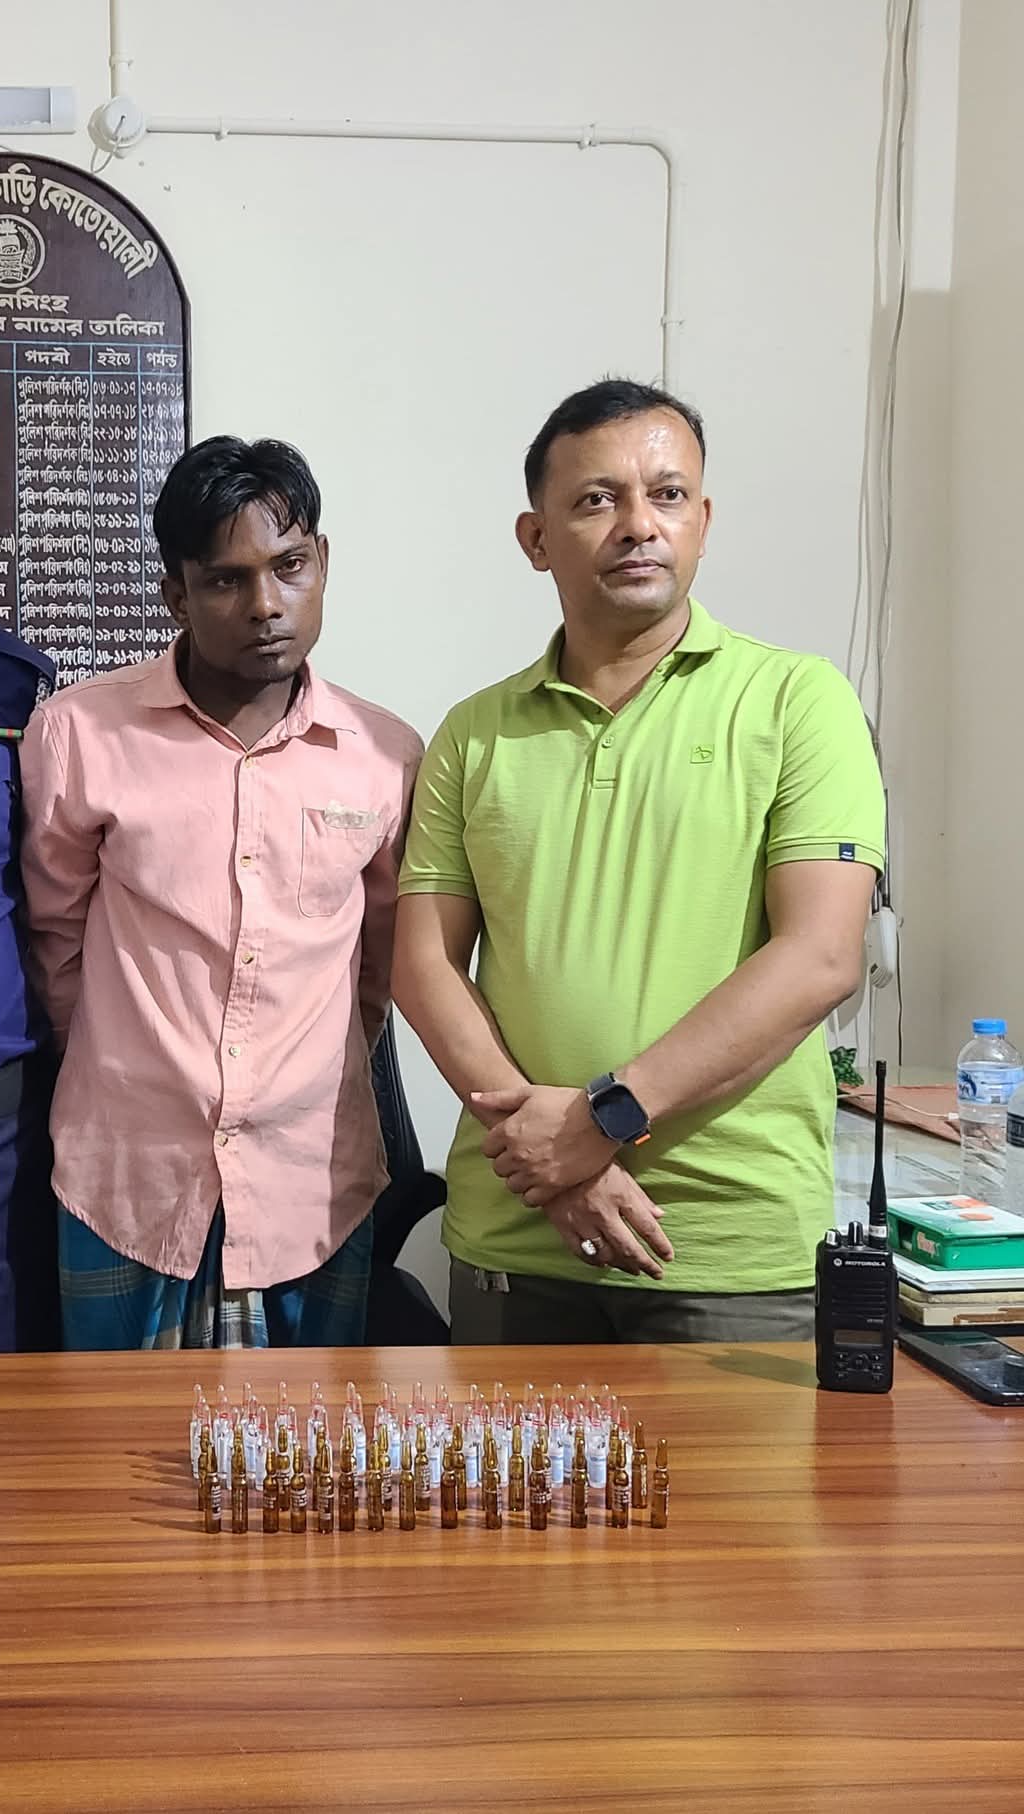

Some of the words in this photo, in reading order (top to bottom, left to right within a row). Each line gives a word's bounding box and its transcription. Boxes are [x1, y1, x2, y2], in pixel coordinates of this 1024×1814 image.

[39, 176, 160, 280] কোতোয়ালী
[12, 316, 83, 337] নামের
[89, 313, 165, 338] তালিকা
[24, 347, 71, 366] পদবী
[97, 347, 131, 367] হইতে
